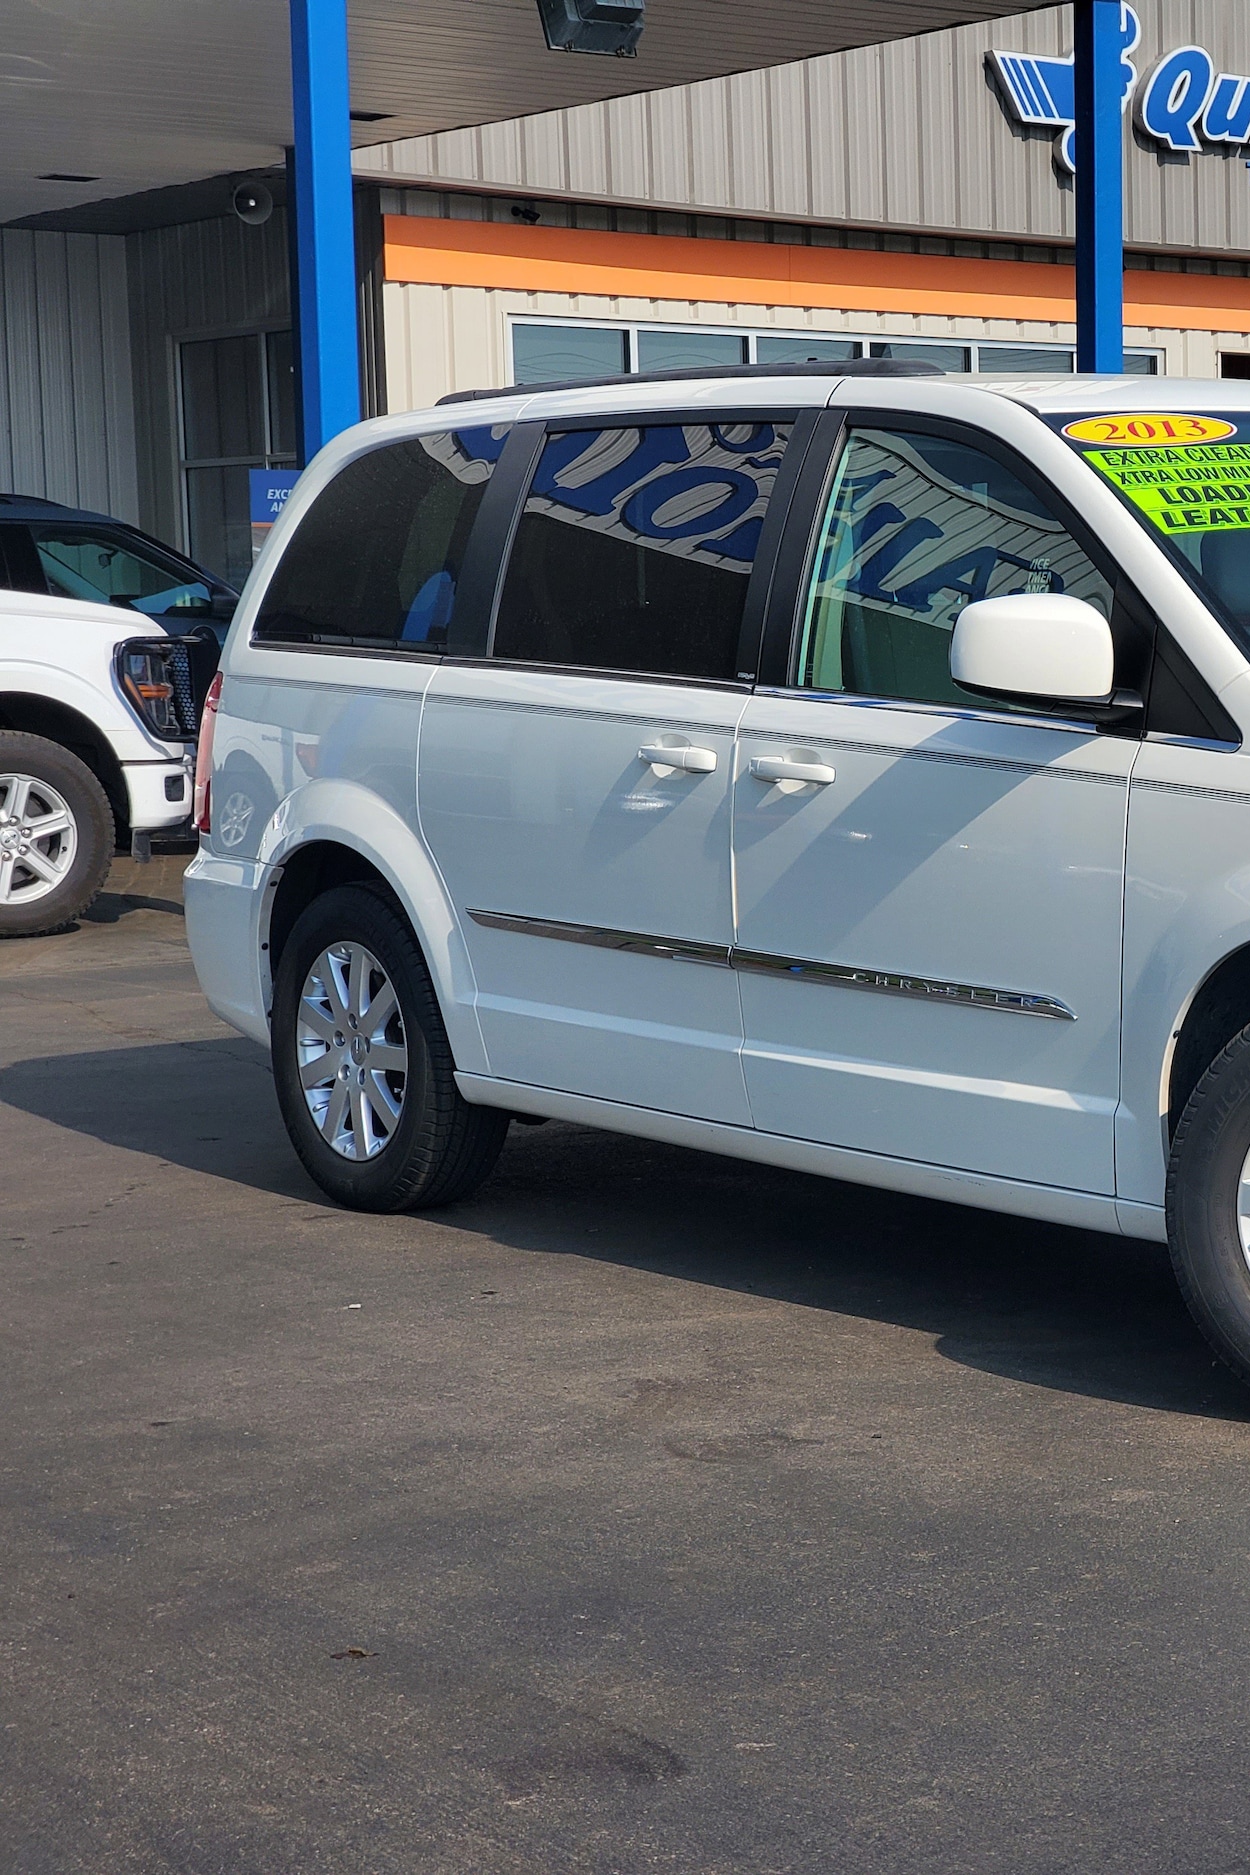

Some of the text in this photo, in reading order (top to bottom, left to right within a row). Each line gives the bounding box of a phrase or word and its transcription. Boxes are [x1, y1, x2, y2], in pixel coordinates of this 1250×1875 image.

[1094, 418, 1208, 441] 2013
[1100, 447, 1186, 468] EXTRA
[1114, 468, 1173, 486] XTRA
[1174, 466, 1222, 483] LOW
